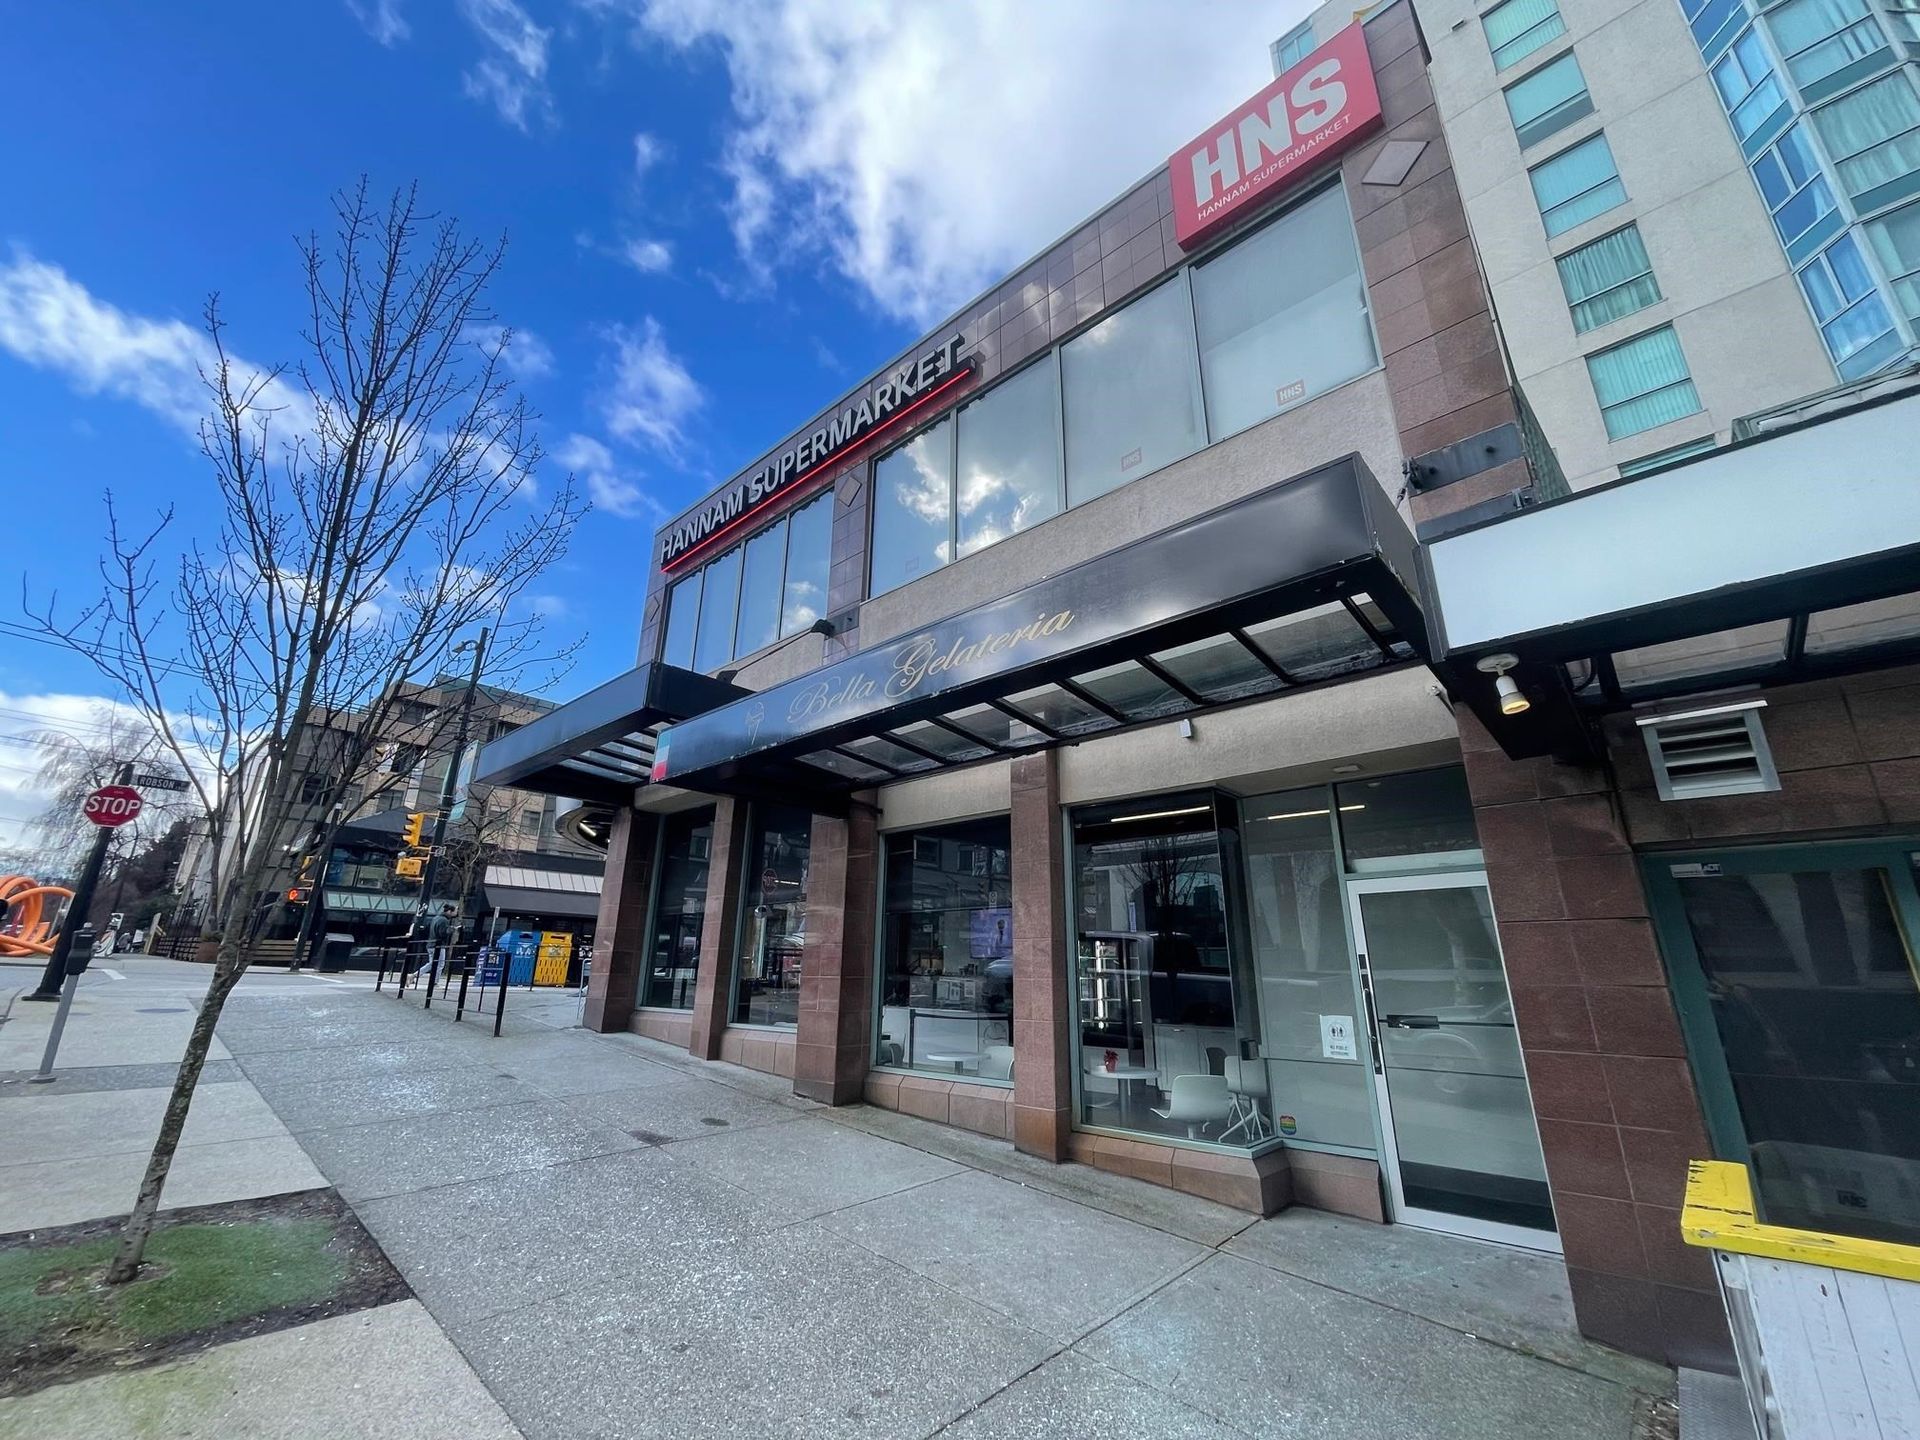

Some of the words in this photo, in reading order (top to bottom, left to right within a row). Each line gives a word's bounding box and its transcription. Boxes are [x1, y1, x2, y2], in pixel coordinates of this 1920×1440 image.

[1191, 57, 1347, 208] HNS
[1198, 183, 1250, 221] HANNAM
[1253, 113, 1351, 185] SUPERMARKET
[1279, 384, 1303, 401] HNS
[660, 485, 746, 564] HANNAM
[748, 332, 962, 504] SUPERMARKET
[787, 673, 876, 723] Bella
[884, 606, 1075, 699] Gelateria
[86, 795, 140, 816] STOP
[140, 776, 175, 789] ROBSON
